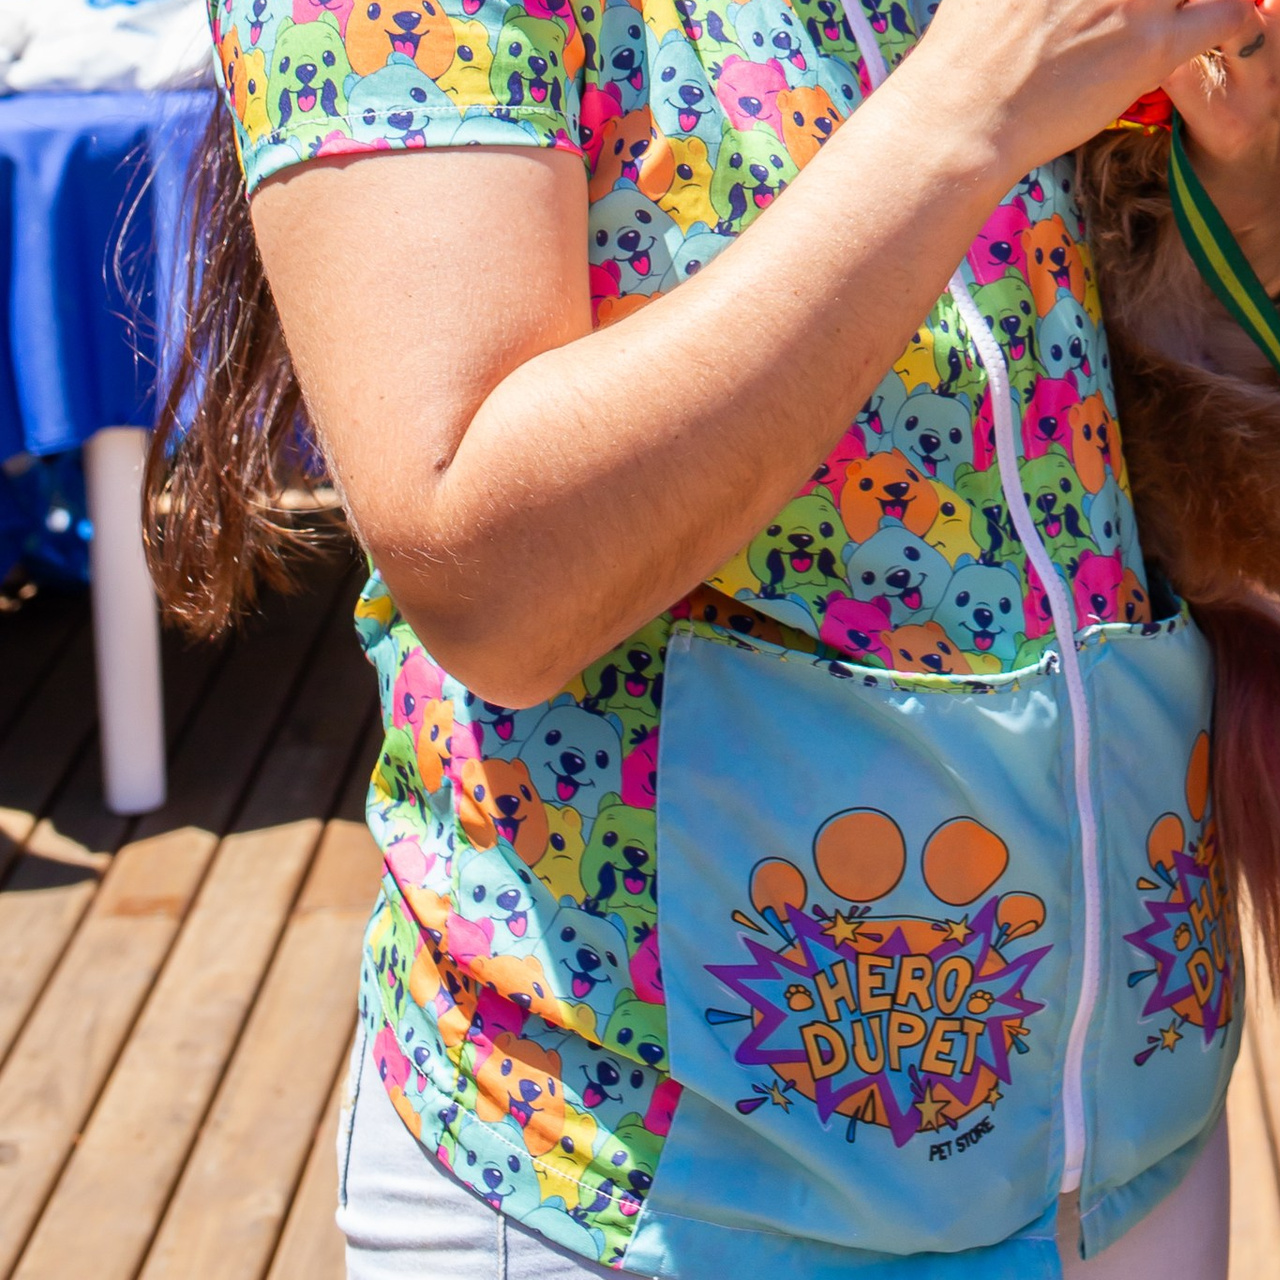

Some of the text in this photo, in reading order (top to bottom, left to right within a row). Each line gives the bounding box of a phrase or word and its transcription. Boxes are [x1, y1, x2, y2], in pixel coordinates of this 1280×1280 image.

[813, 951, 975, 1023] HERO
[799, 1008, 987, 1082] DUPET
[929, 1115, 995, 1161] PET STORE
